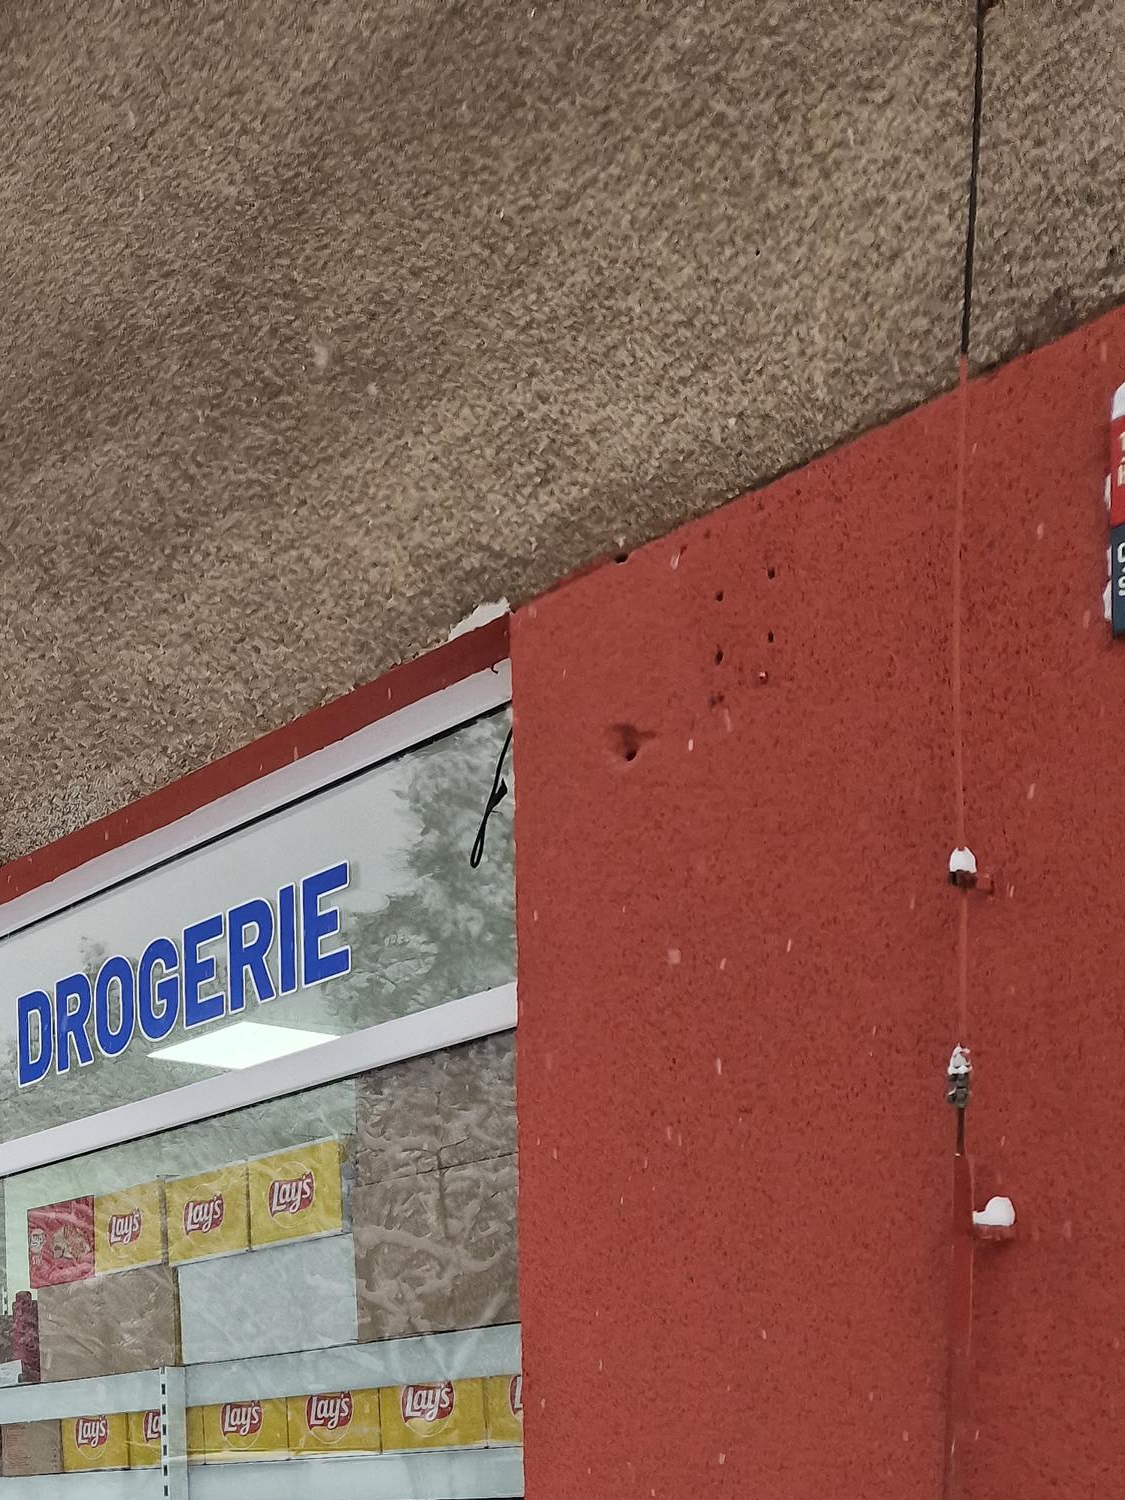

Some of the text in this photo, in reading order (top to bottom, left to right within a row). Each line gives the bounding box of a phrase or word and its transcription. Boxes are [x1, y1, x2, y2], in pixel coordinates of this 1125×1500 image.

[16, 859, 352, 1088] DROGERIE
[271, 1173, 312, 1214] Lay's
[110, 1210, 141, 1245] Lay's
[186, 1194, 222, 1234] Lay's
[224, 1402, 261, 1436] Lay's
[310, 1393, 350, 1430] Lay's
[405, 1382, 452, 1422] Lay's
[77, 1415, 107, 1447] Lay's
